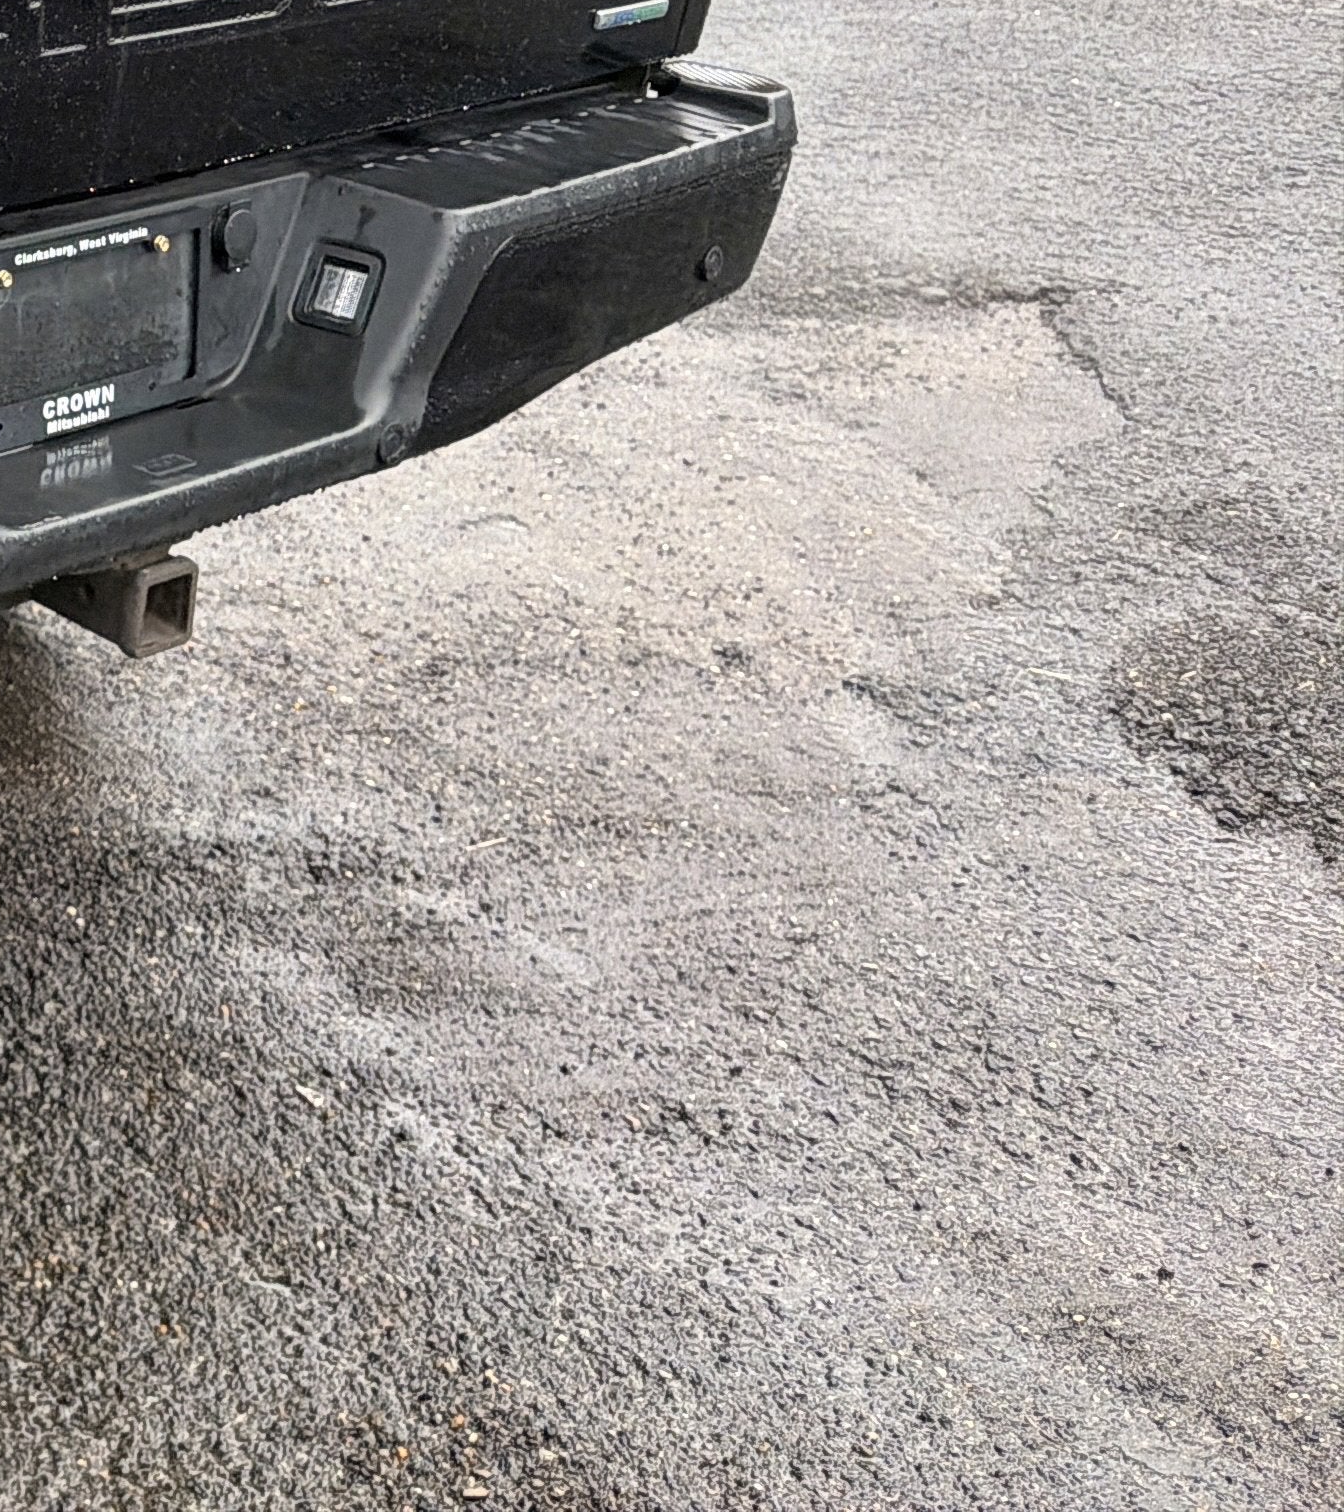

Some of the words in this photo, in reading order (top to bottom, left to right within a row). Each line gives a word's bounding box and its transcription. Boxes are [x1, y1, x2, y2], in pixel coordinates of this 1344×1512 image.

[14, 243, 77, 266] Clarksburg,
[79, 235, 106, 251] West
[108, 226, 149, 244] Virginia
[42, 383, 115, 419] CROWN
[46, 405, 110, 435] Mitsubishi
